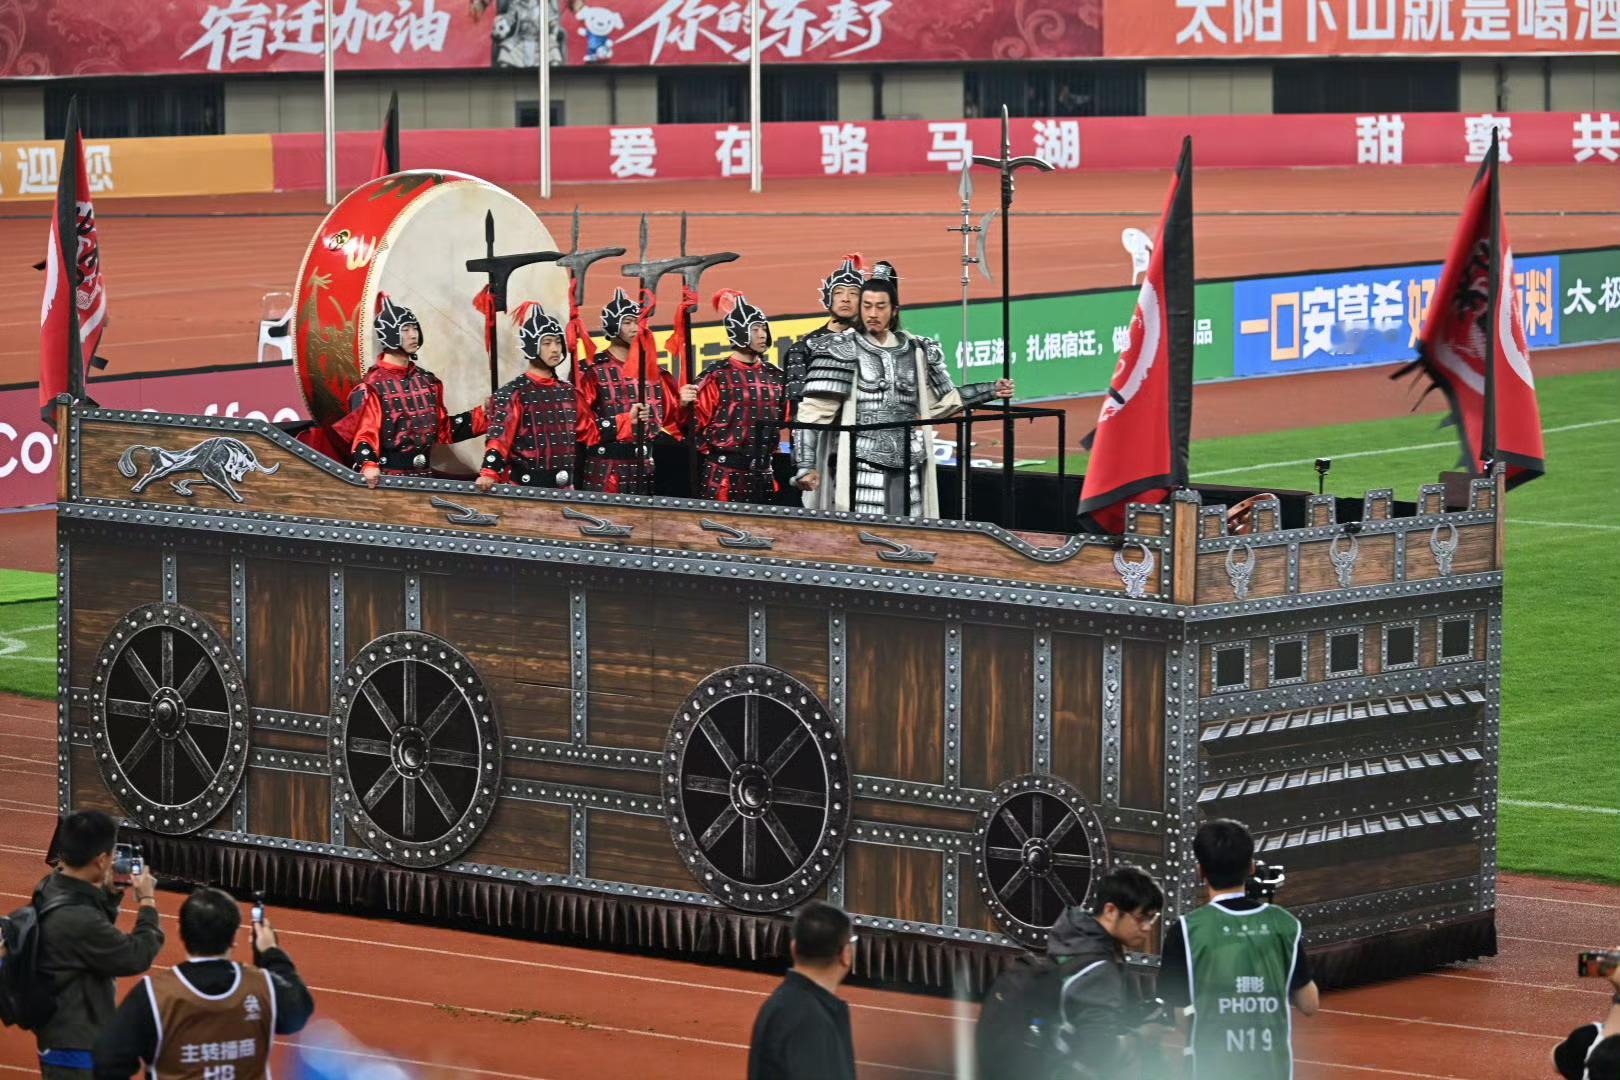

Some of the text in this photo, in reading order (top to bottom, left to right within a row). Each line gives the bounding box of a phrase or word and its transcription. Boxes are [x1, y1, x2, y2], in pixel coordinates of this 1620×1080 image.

[178, 0, 451, 71] 宿迁加油
[0, 145, 114, 194] 迎您
[609, 113, 1620, 177] 爱在骆马湖 甜蜜共
[1218, 996, 1279, 1014] PHOTO
[1226, 1027, 1272, 1052] N19
